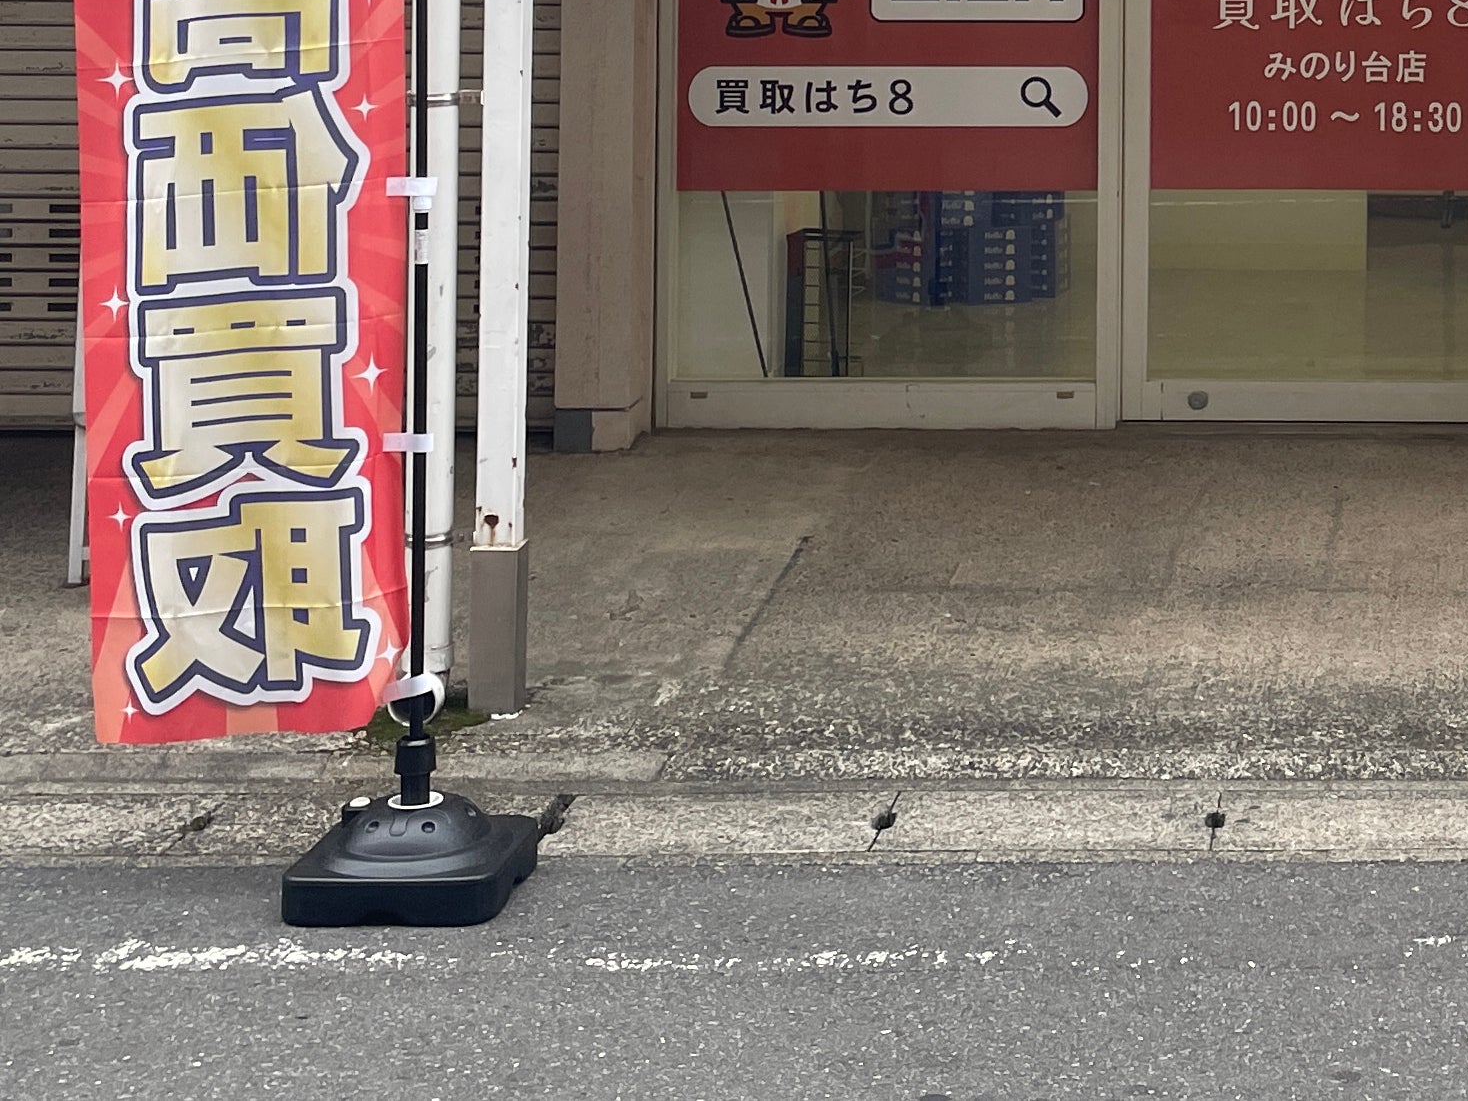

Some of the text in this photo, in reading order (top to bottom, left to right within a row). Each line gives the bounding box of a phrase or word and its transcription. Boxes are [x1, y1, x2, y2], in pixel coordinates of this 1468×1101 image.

[1264, 50, 1427, 83] みのり台店
[715, 79, 914, 115] 買取はち8
[1228, 100, 1317, 133] 10:00
[1374, 100, 1462, 133] 18:30
